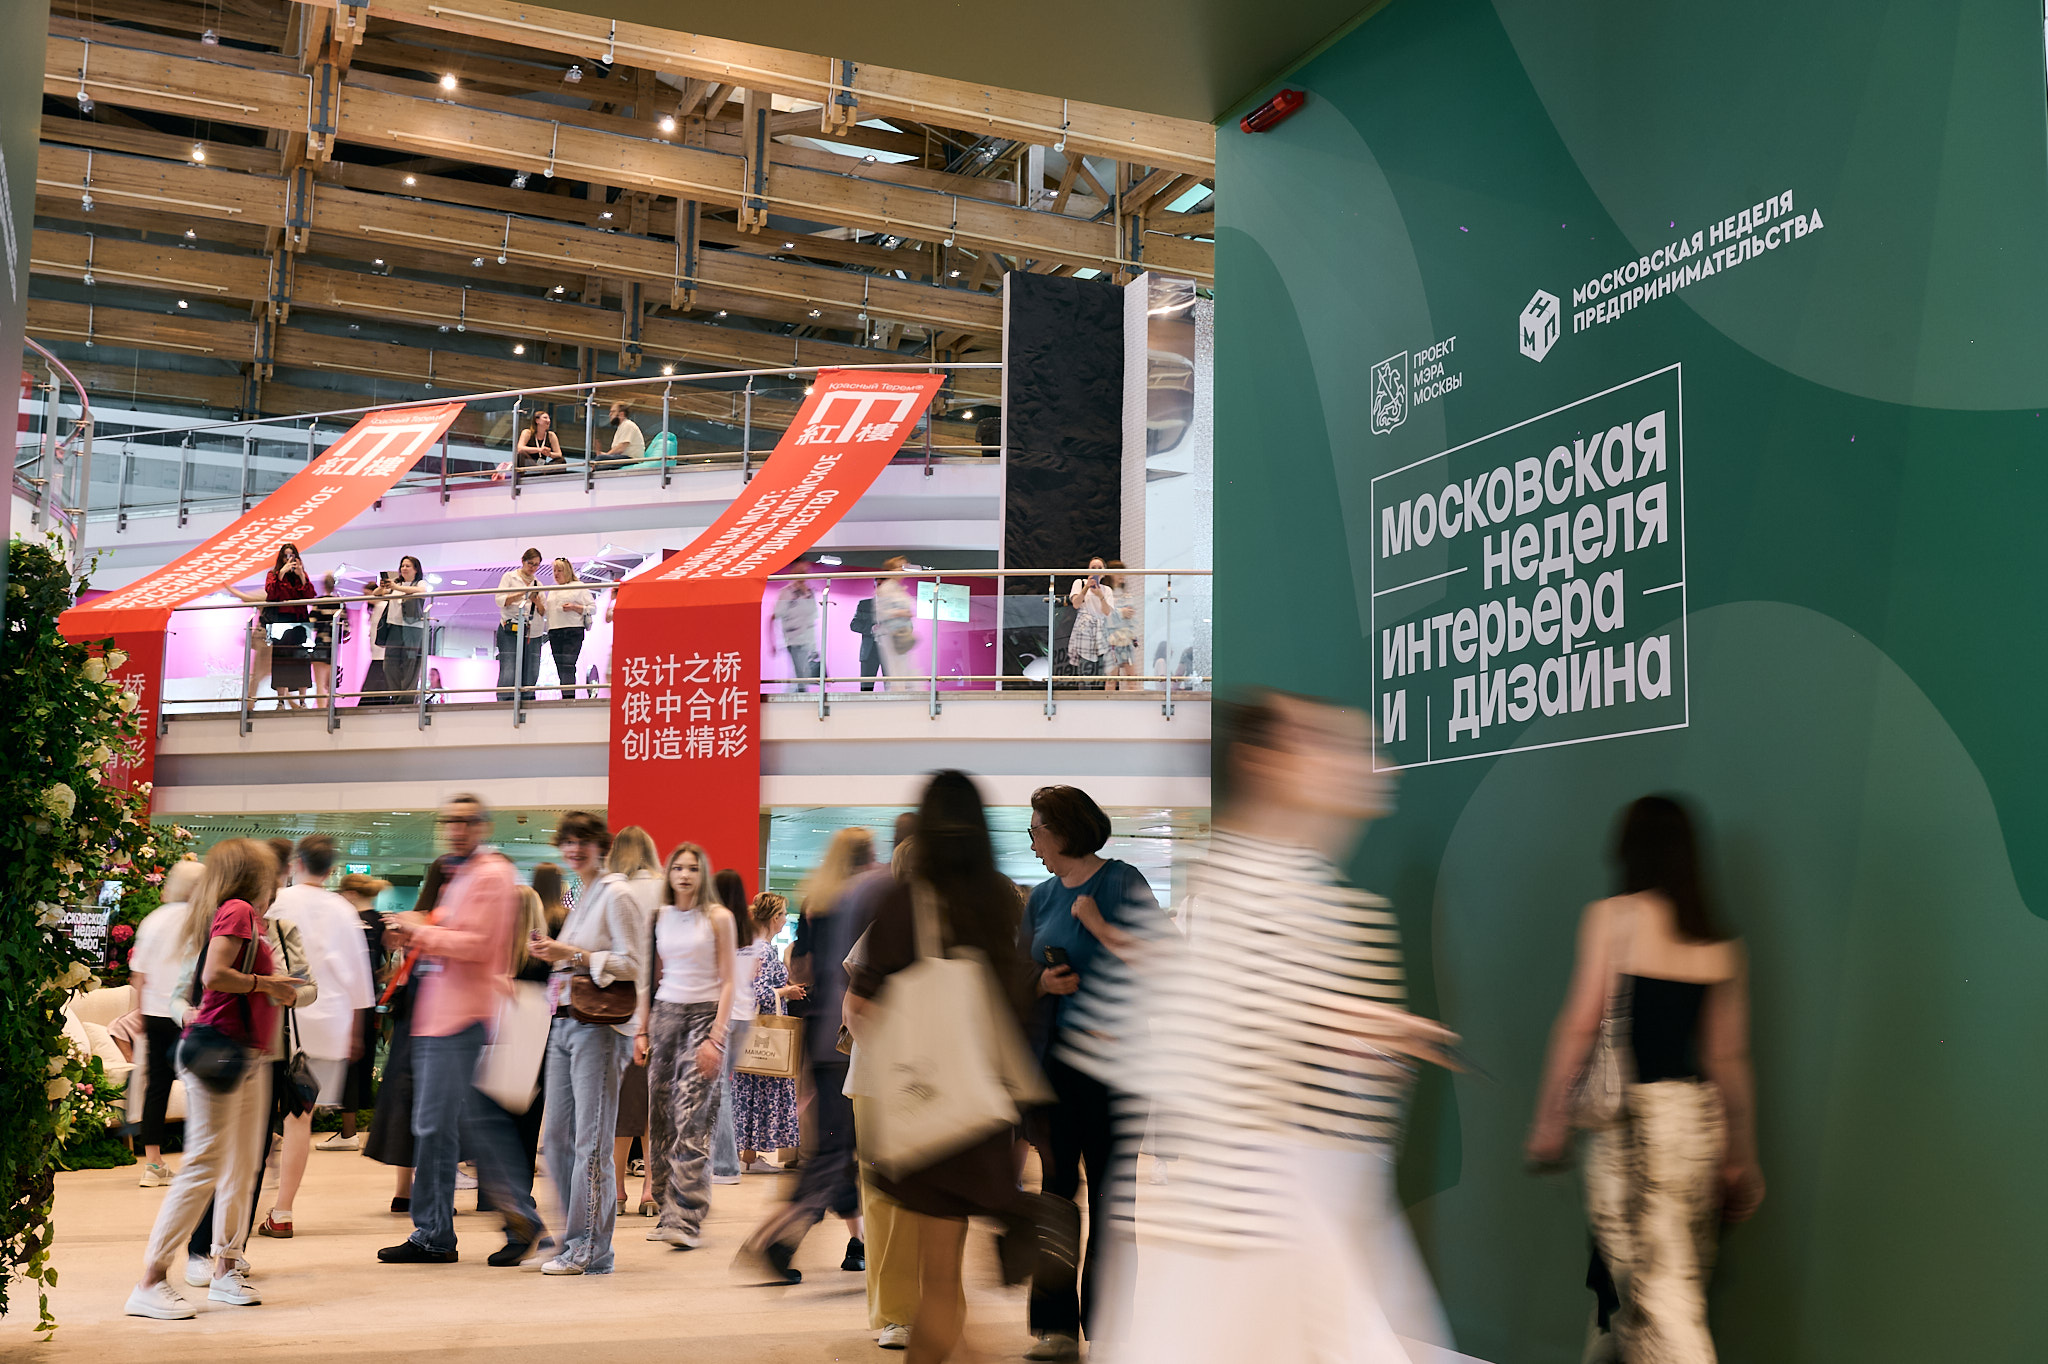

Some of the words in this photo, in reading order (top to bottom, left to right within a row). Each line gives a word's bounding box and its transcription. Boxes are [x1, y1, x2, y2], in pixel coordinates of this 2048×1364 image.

[1573, 231, 1703, 308] МОСКОВСКАЯ
[1709, 189, 1794, 245] НЕДЕЛЯ
[1573, 208, 1824, 334] ПРЕДПРИНИМАТЕЛЬСТВА
[1413, 336, 1457, 369] ПРОЕКТ
[1413, 362, 1445, 388] МЭРА
[828, 382, 879, 391] Красный
[1413, 372, 1463, 406] МОСКВЫ
[1382, 410, 1667, 559] московская
[173, 550, 221, 573] КАК
[214, 515, 277, 551] МОСТ:
[687, 453, 843, 579] РОССИЙСКО-КИТАЙСКОЕ
[711, 524, 754, 547] КАК
[736, 489, 787, 525] МОСТ:
[721, 489, 840, 577] СОТРУДНИЧЕСТВО
[1483, 481, 1668, 591] неделя
[117, 486, 343, 609] РОССИЙСКО-КИТАЙСКОЕ
[144, 525, 315, 608] СОТРУДНИЧЕСТВО
[1382, 568, 1625, 681] интерьера
[621, 651, 742, 688] 设计之桥
[1382, 688, 1407, 745] и
[1448, 634, 1672, 743] дизайна
[621, 686, 749, 725] 俄中合作
[621, 724, 749, 762] 创造精彩
[73, 925, 107, 938] неделя
[744, 1049, 776, 1057] MAIMOON
